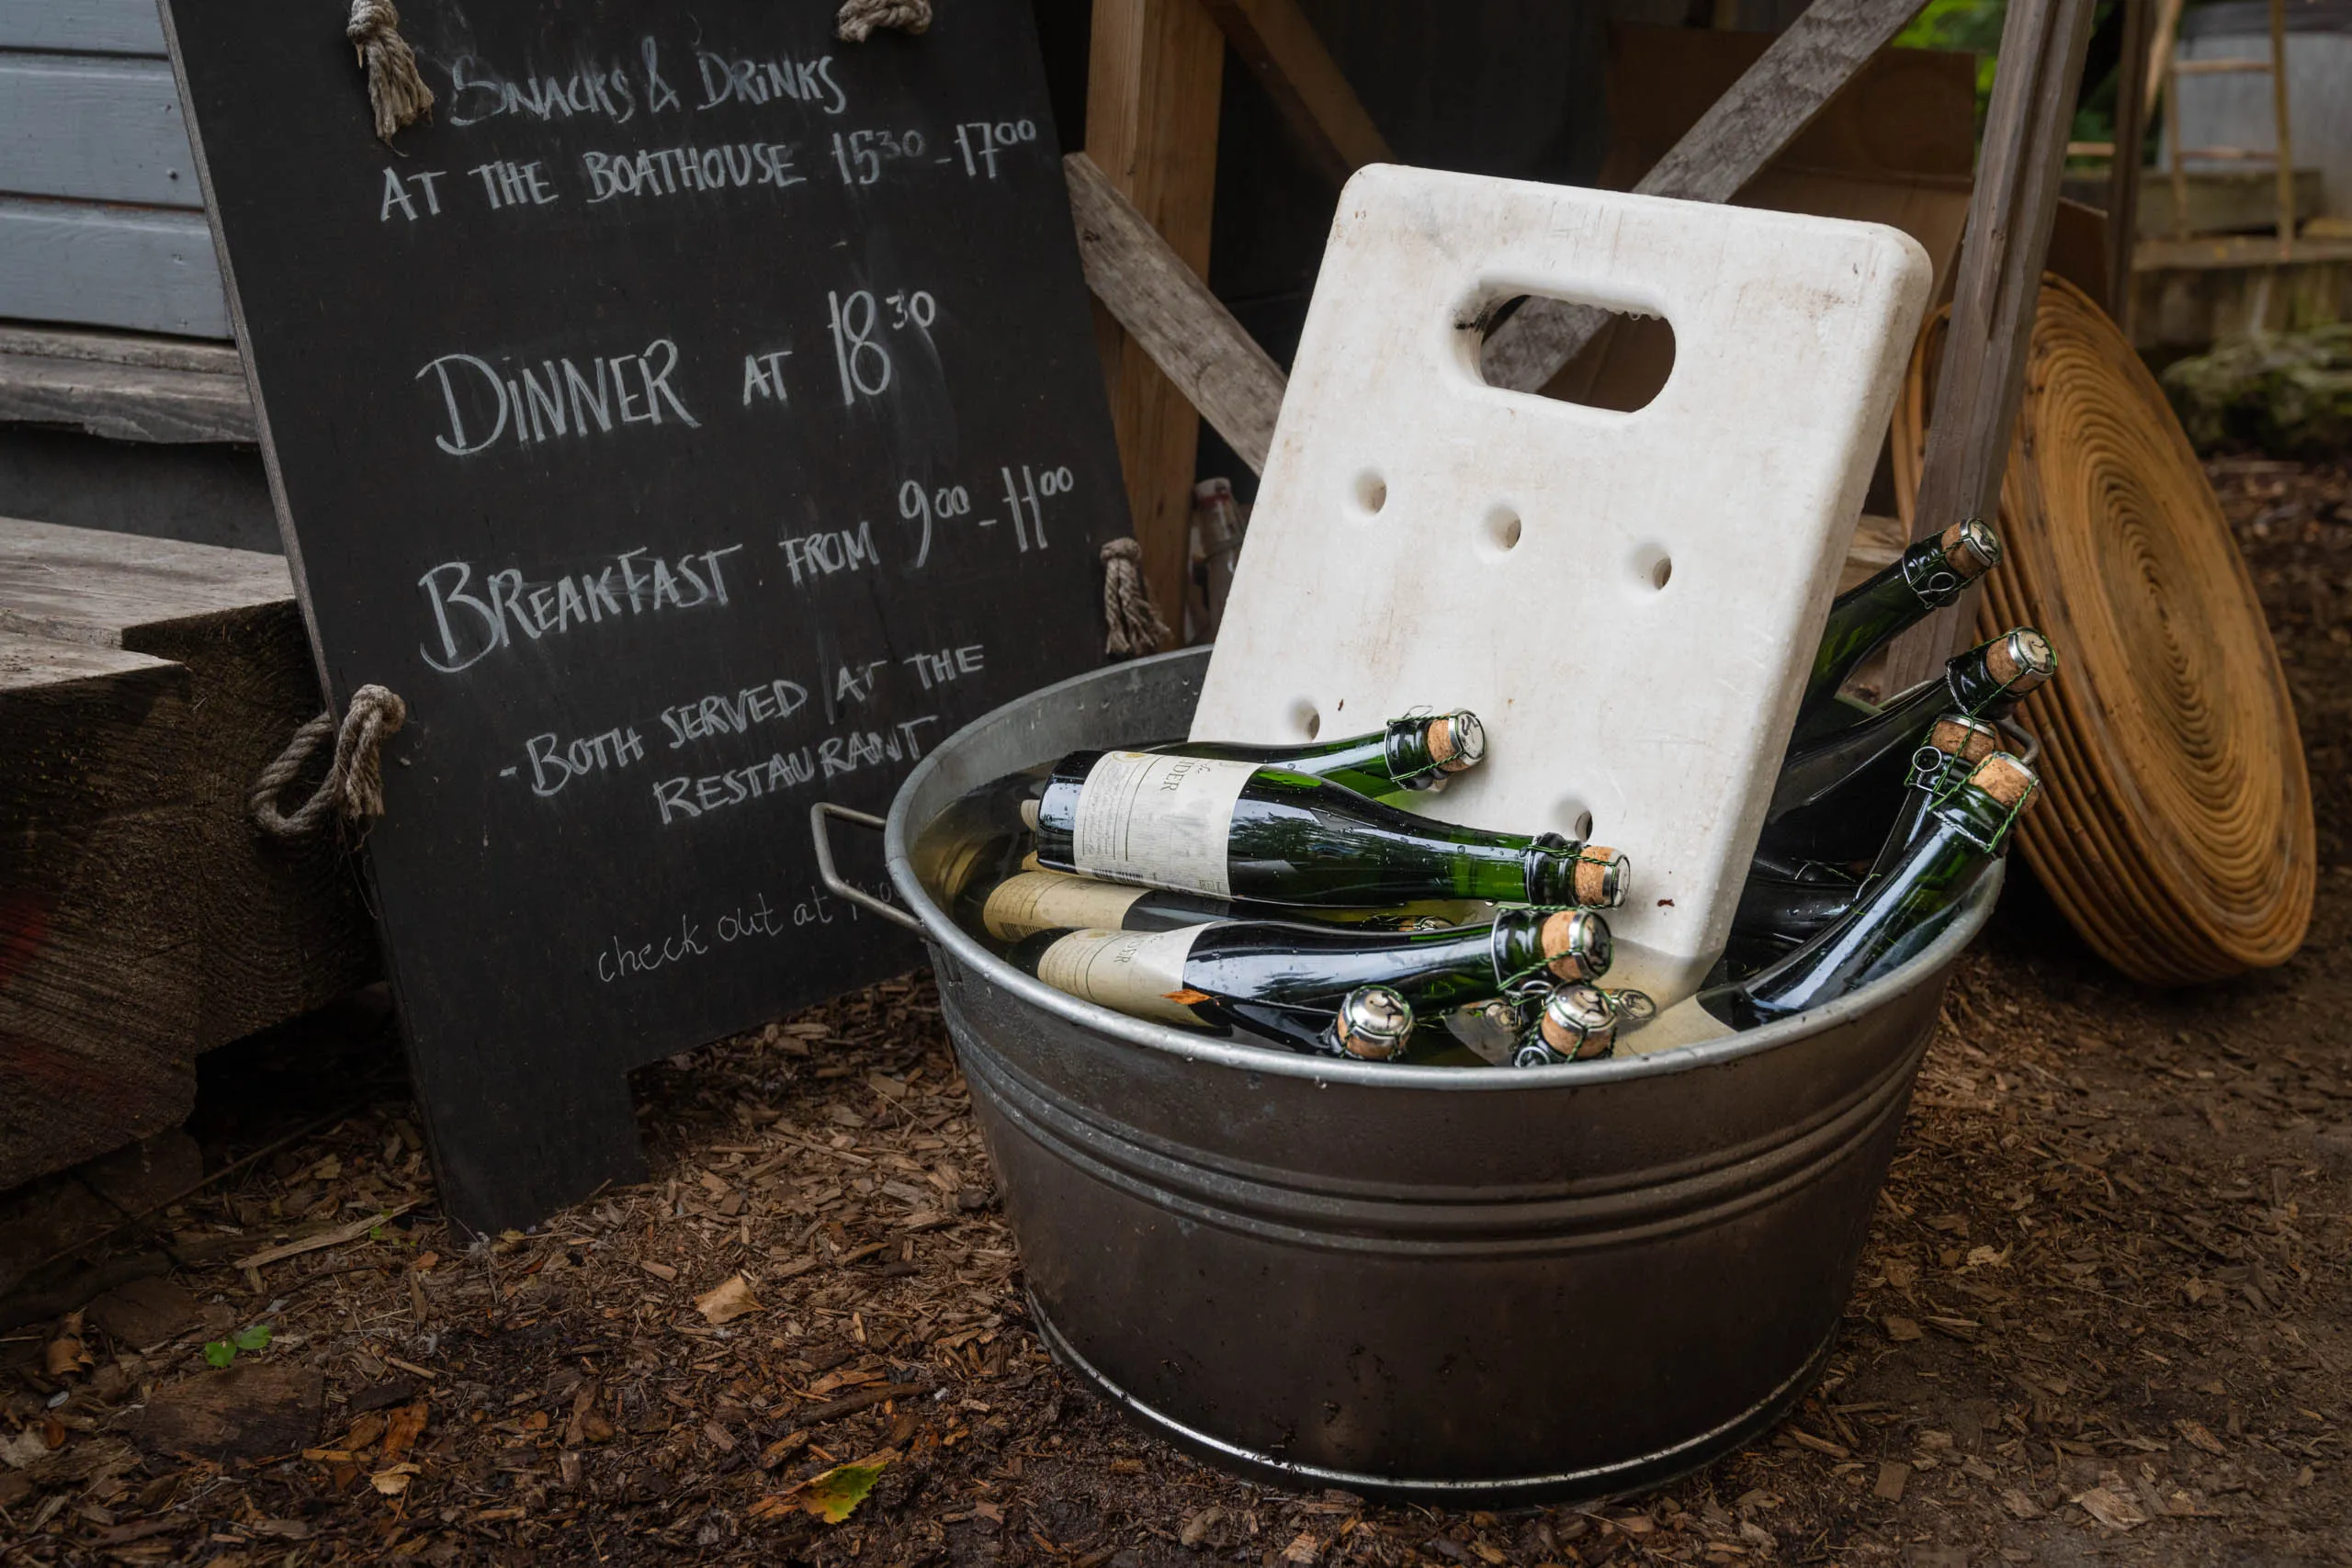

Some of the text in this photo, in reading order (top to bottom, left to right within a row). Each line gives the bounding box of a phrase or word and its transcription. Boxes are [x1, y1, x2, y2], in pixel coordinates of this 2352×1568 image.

[643, 36, 681, 113] &
[380, 166, 447, 222] AT
[468, 160, 559, 209] THE
[583, 142, 808, 203] BOATHOUSE
[743, 350, 793, 406] AT
[418, 543, 743, 673] BREAKFAST
[778, 521, 880, 586] FROM
[661, 679, 808, 749] SERVED
[836, 660, 887, 703] AT
[902, 644, 984, 690] THE
[653, 715, 938, 825] RESTAURANT
[598, 913, 707, 983] check
[718, 892, 784, 942] out
[794, 885, 833, 926] at
